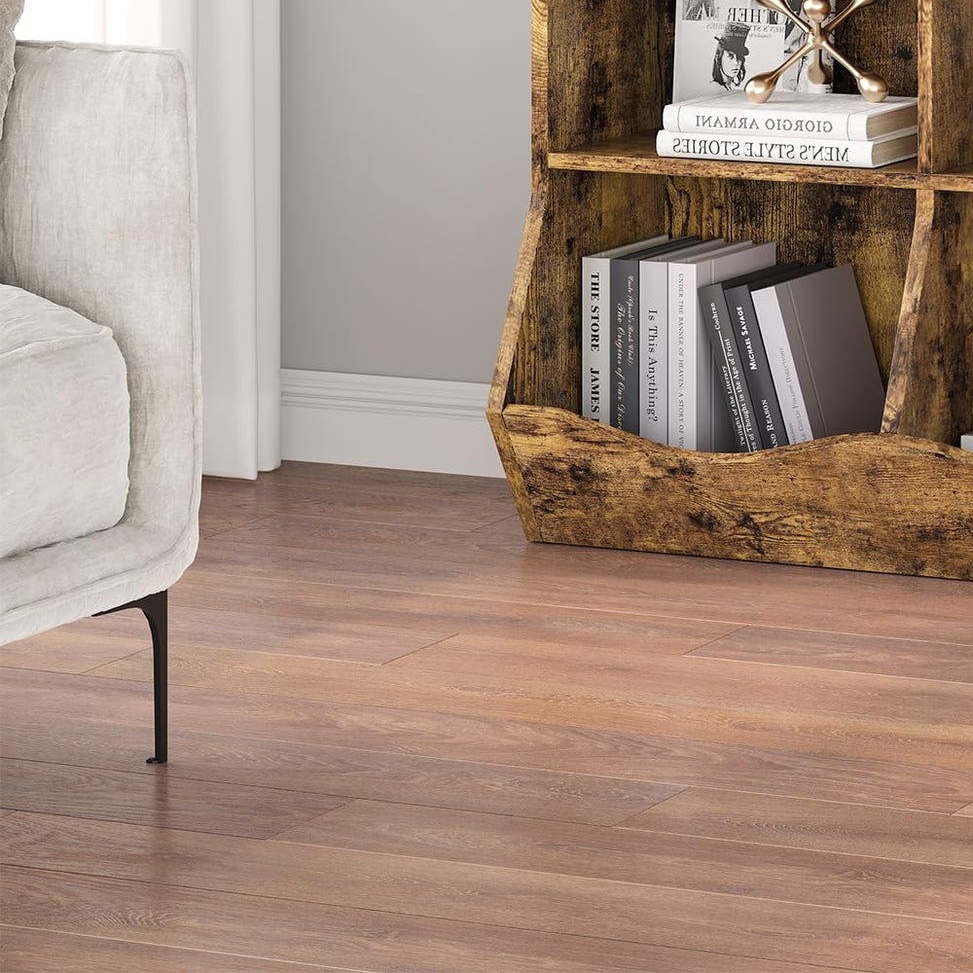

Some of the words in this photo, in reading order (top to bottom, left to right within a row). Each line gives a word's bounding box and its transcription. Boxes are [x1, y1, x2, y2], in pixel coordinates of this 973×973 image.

[590, 272, 600, 301] THE
[616, 302, 626, 324] The
[648, 309, 658, 321] Is
[710, 302, 720, 330] Cochran
[737, 307, 748, 336] SAVAGE
[590, 305, 600, 352] STORE
[648, 326, 658, 354] This
[614, 326, 626, 365] Origins
[678, 347, 685, 357] OF
[725, 339, 734, 357] Print
[745, 338, 757, 371] MICHAEL
[614, 367, 626, 380] of
[729, 357, 735, 365] of
[732, 367, 740, 380] Age
[590, 368, 600, 413] JAMES
[617, 382, 626, 401] Our
[646, 357, 658, 423] Anything?
[721, 366, 732, 394] Literary
[735, 381, 743, 393] the
[732, 408, 737, 416] of
[741, 403, 752, 432] Thought
[678, 424, 685, 435] OF
[735, 417, 745, 445] Twilight
